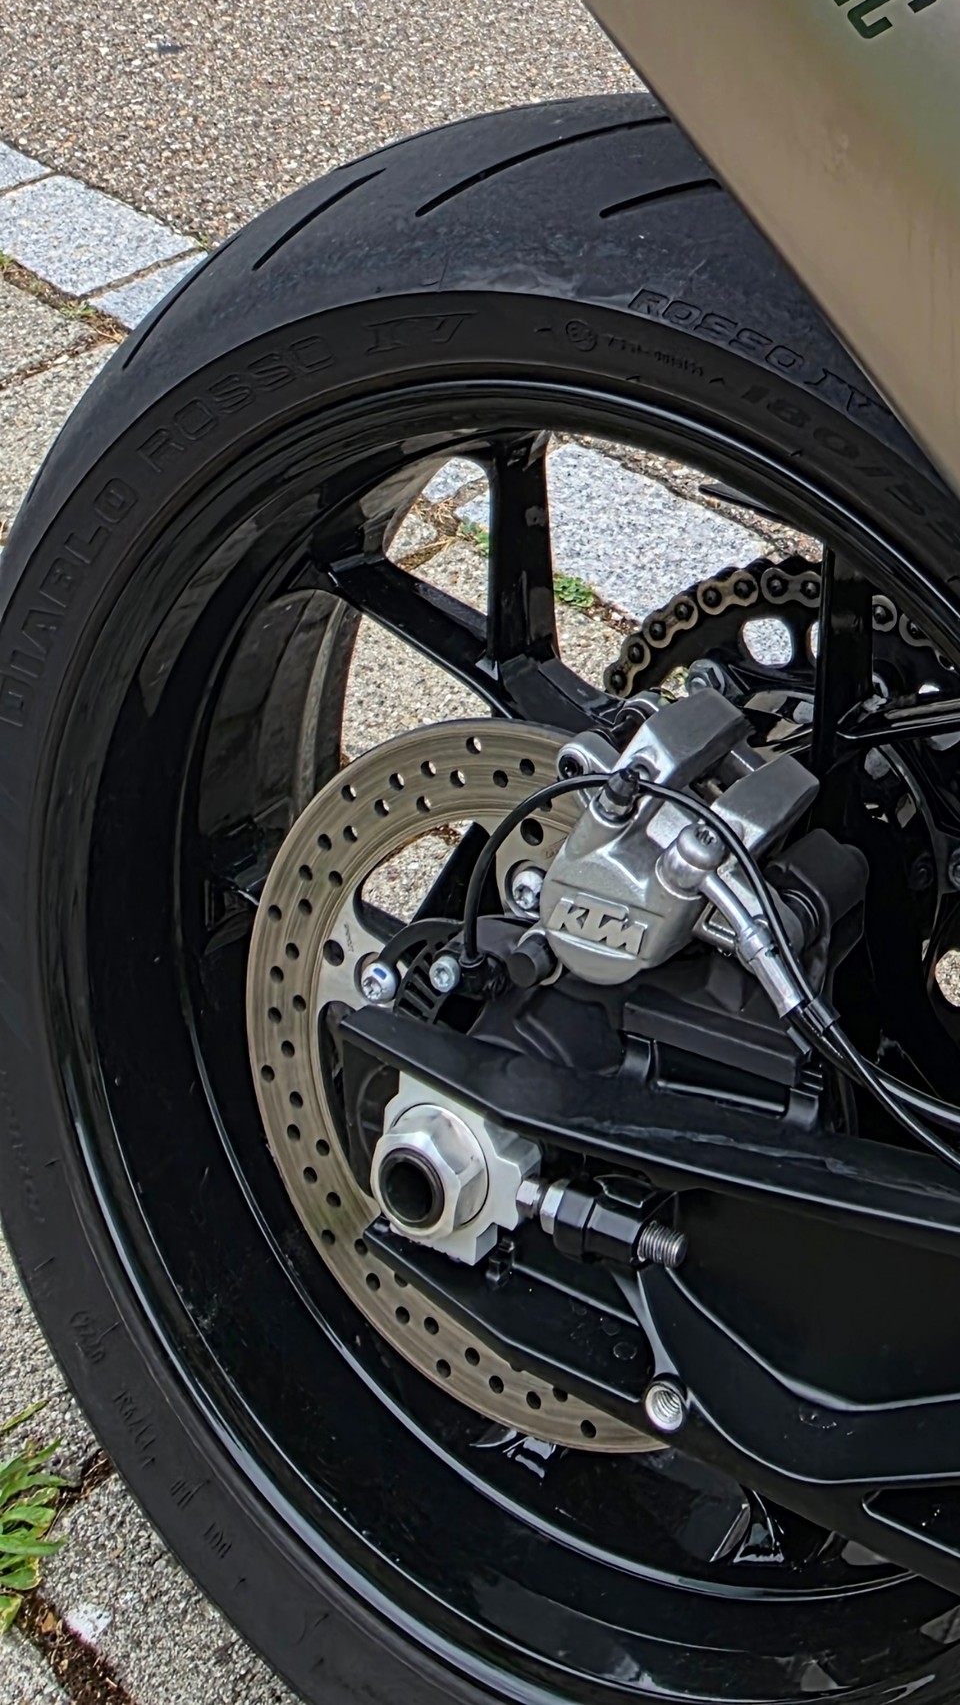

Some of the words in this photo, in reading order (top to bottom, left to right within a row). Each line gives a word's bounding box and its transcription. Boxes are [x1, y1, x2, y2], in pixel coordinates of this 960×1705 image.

[627, 288, 804, 371] ROSSO
[0, 476, 139, 728] DIABLO
[136, 334, 335, 473] ROSSO
[547, 892, 648, 956] KTM
